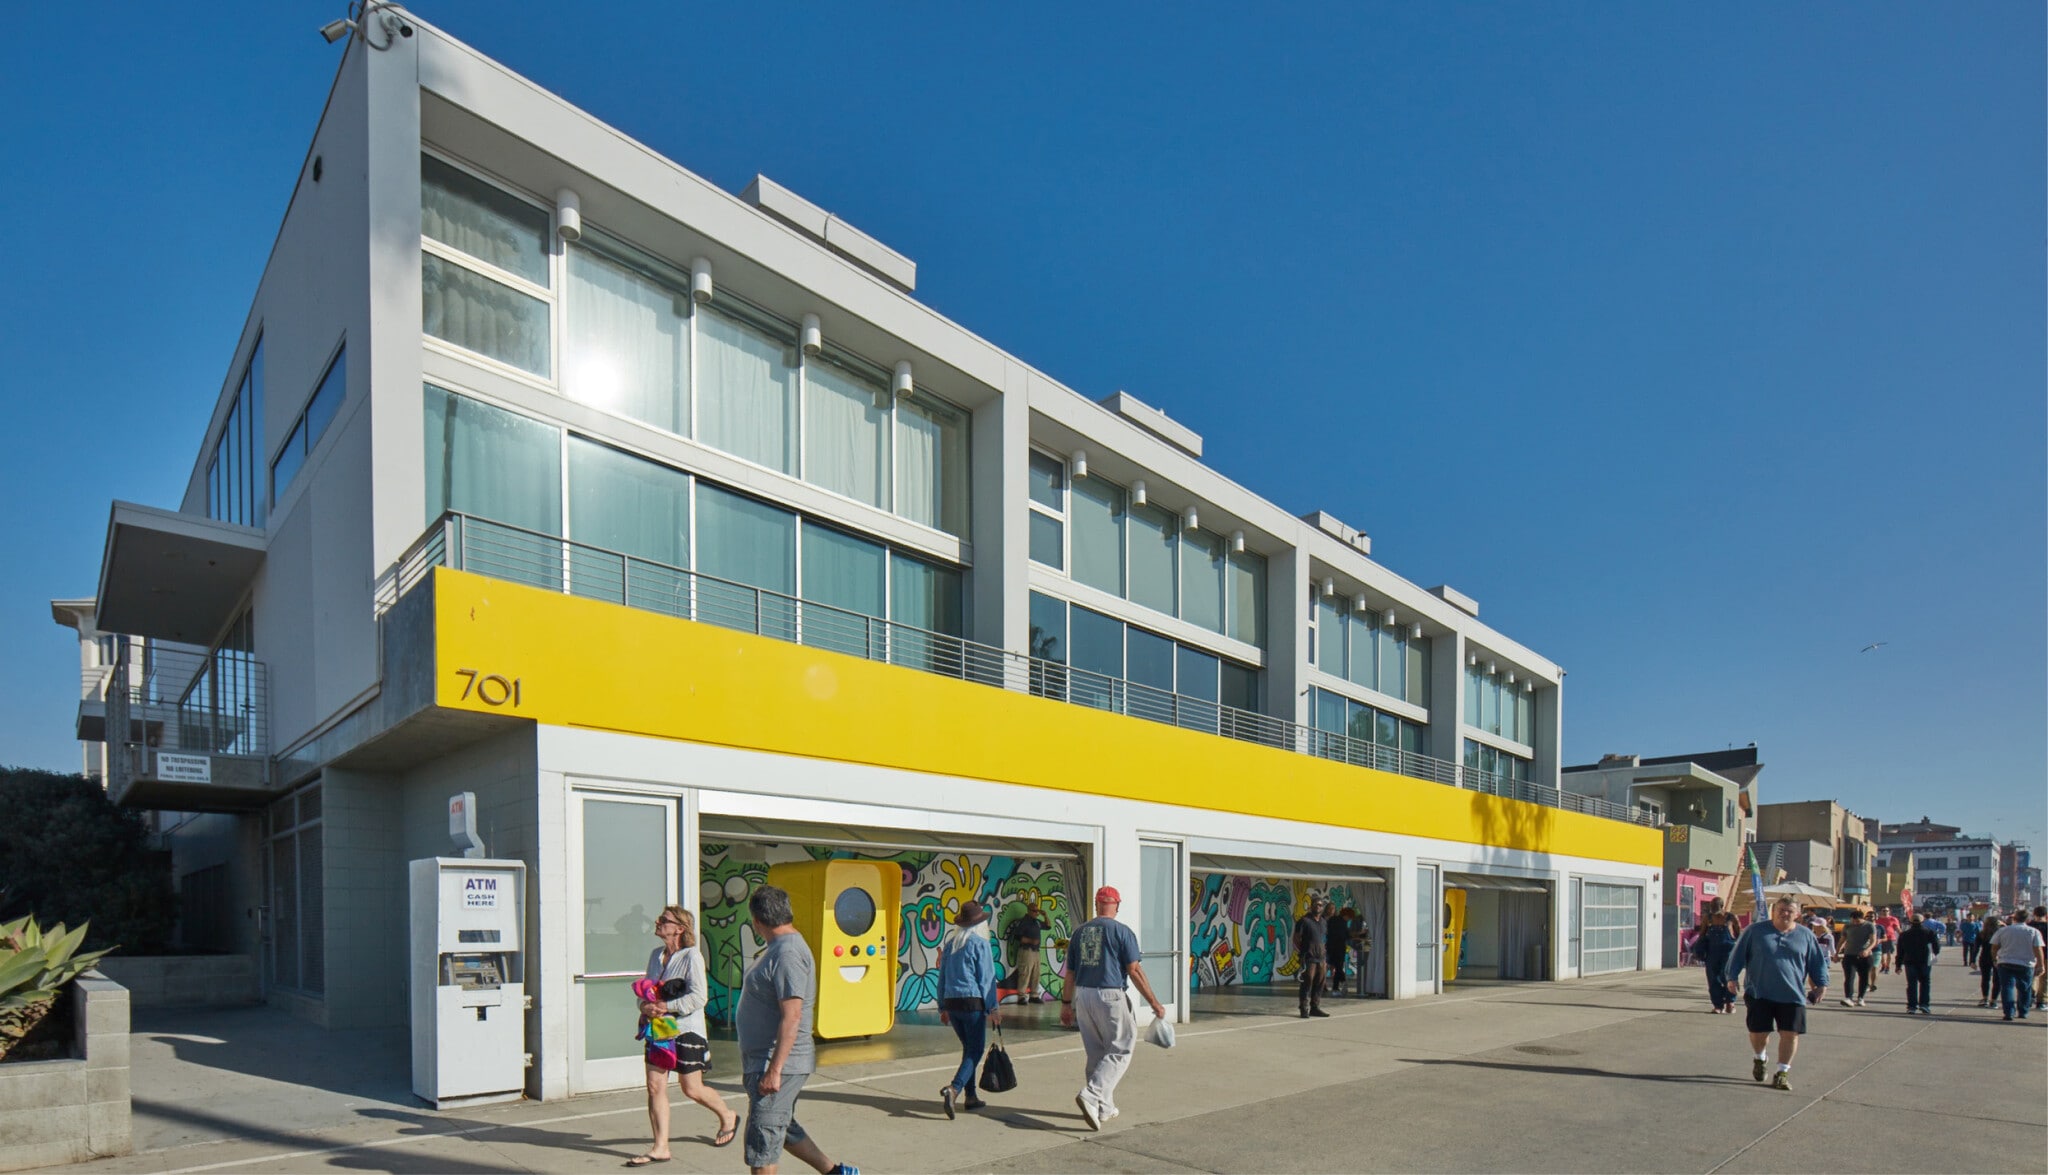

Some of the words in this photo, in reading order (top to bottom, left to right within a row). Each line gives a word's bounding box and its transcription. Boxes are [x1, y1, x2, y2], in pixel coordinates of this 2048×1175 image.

[455, 667, 521, 708] 701
[451, 800, 464, 815] ATM
[465, 878, 497, 890] ATM
